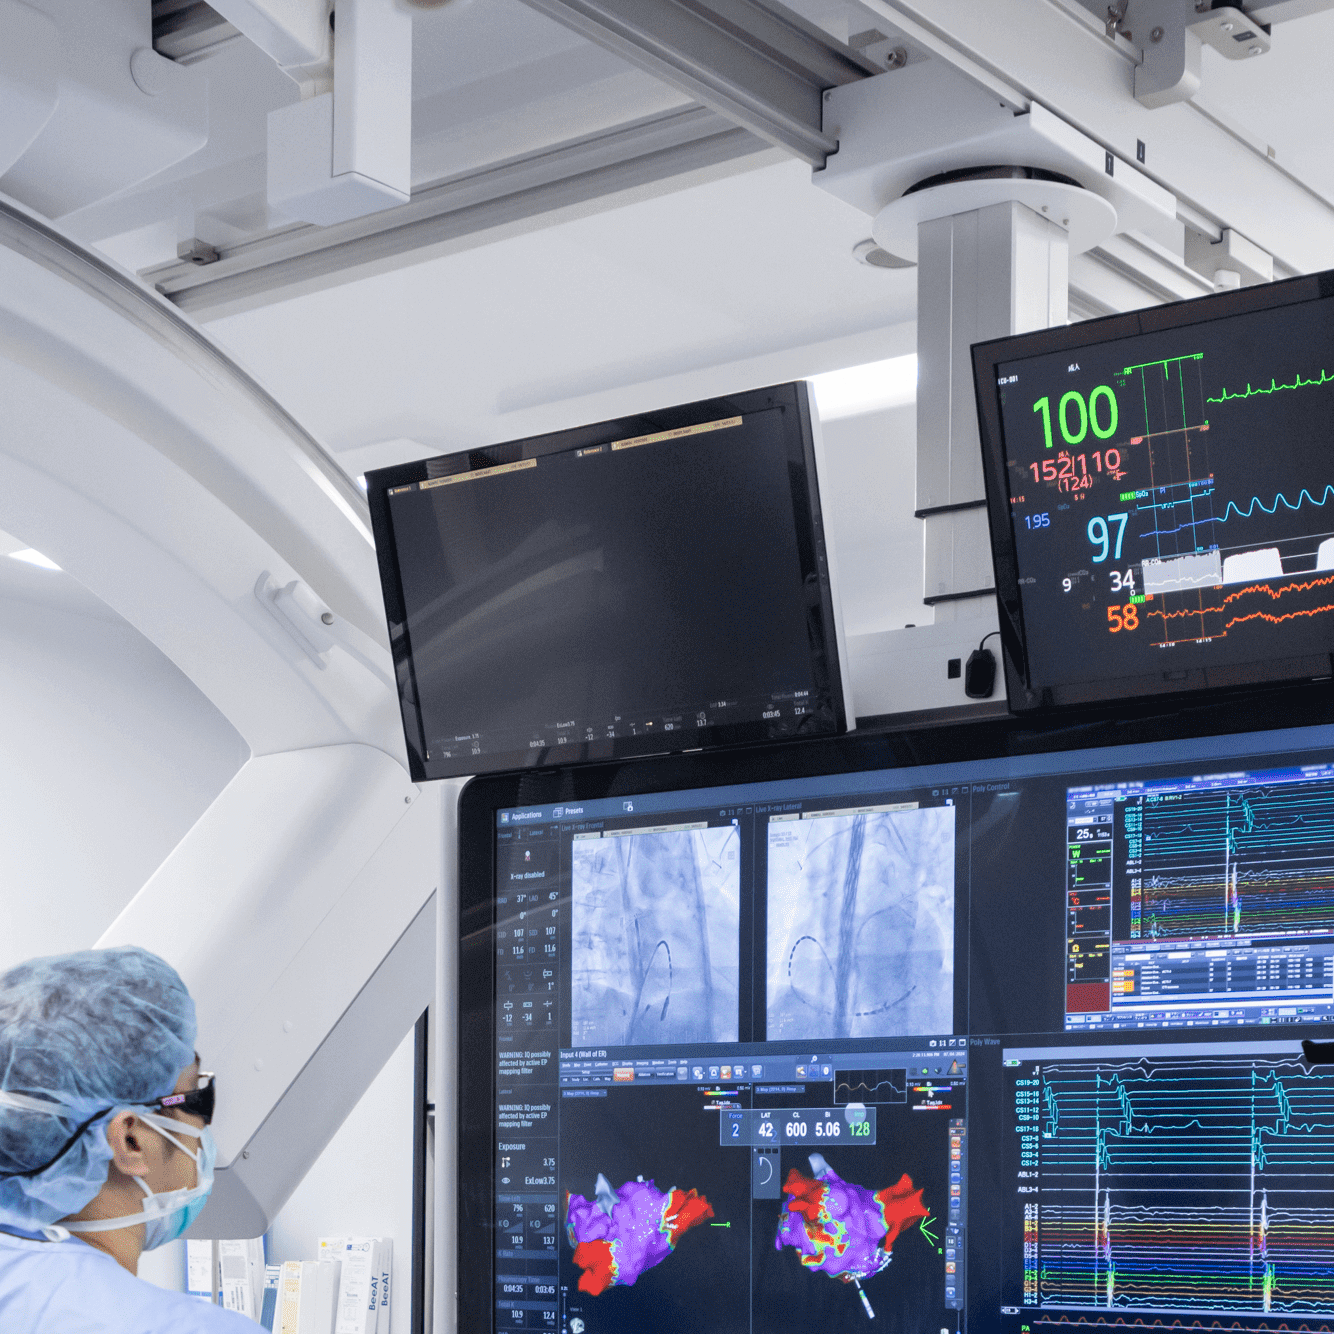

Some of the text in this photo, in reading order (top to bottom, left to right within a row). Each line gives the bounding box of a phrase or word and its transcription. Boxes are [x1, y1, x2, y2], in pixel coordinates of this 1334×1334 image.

[1033, 385, 1118, 448] 100
[1030, 449, 1121, 482] 152/110
[1058, 475, 1093, 492] (124)
[1025, 513, 1051, 529] 1.95
[1087, 513, 1129, 563] 97
[1109, 569, 1135, 591] 34
[1062, 578, 1072, 592] 9
[1107, 603, 1139, 632] 58
[762, 710, 780, 718] 0:03:45
[794, 707, 805, 715] 12.4
[585, 733, 594, 741] -12
[973, 783, 1010, 794] Poly Control
[565, 806, 584, 815] Presets
[511, 810, 542, 821] Applications
[510, 871, 545, 880] X-ray disabled
[549, 892, 558, 900] 45°
[514, 929, 524, 937] 107
[546, 927, 556, 935] 107
[513, 946, 524, 954] 11.6
[544, 944, 556, 953] 11.6
[502, 1014, 513, 1022] -12
[522, 1013, 532, 1021] -34
[970, 1036, 1001, 1047] Poly Wave
[531, 1051, 551, 1059] possibly
[499, 1068, 521, 1076] mapping
[854, 1111, 864, 1119] Imp
[732, 1123, 739, 1137] 2
[759, 1123, 773, 1137] 42
[786, 1122, 807, 1137] 600
[815, 1122, 841, 1137] 5.06
[849, 1122, 870, 1137] 128
[499, 1142, 526, 1151] Exposure
[543, 1158, 555, 1166] 3.75
[525, 1177, 555, 1185] ExLow3.75
[513, 1204, 523, 1212] 796
[544, 1204, 555, 1212] 620
[512, 1236, 523, 1244] 10.9
[543, 1236, 555, 1245] 13.7
[369, 1276, 379, 1311] BeeAT
[381, 1272, 389, 1306] BeeAT
[504, 1285, 523, 1293] 0:04:35
[535, 1286, 555, 1294] 0:03:45
[512, 1310, 523, 1318] 10.9
[543, 1312, 555, 1320] 12.4
